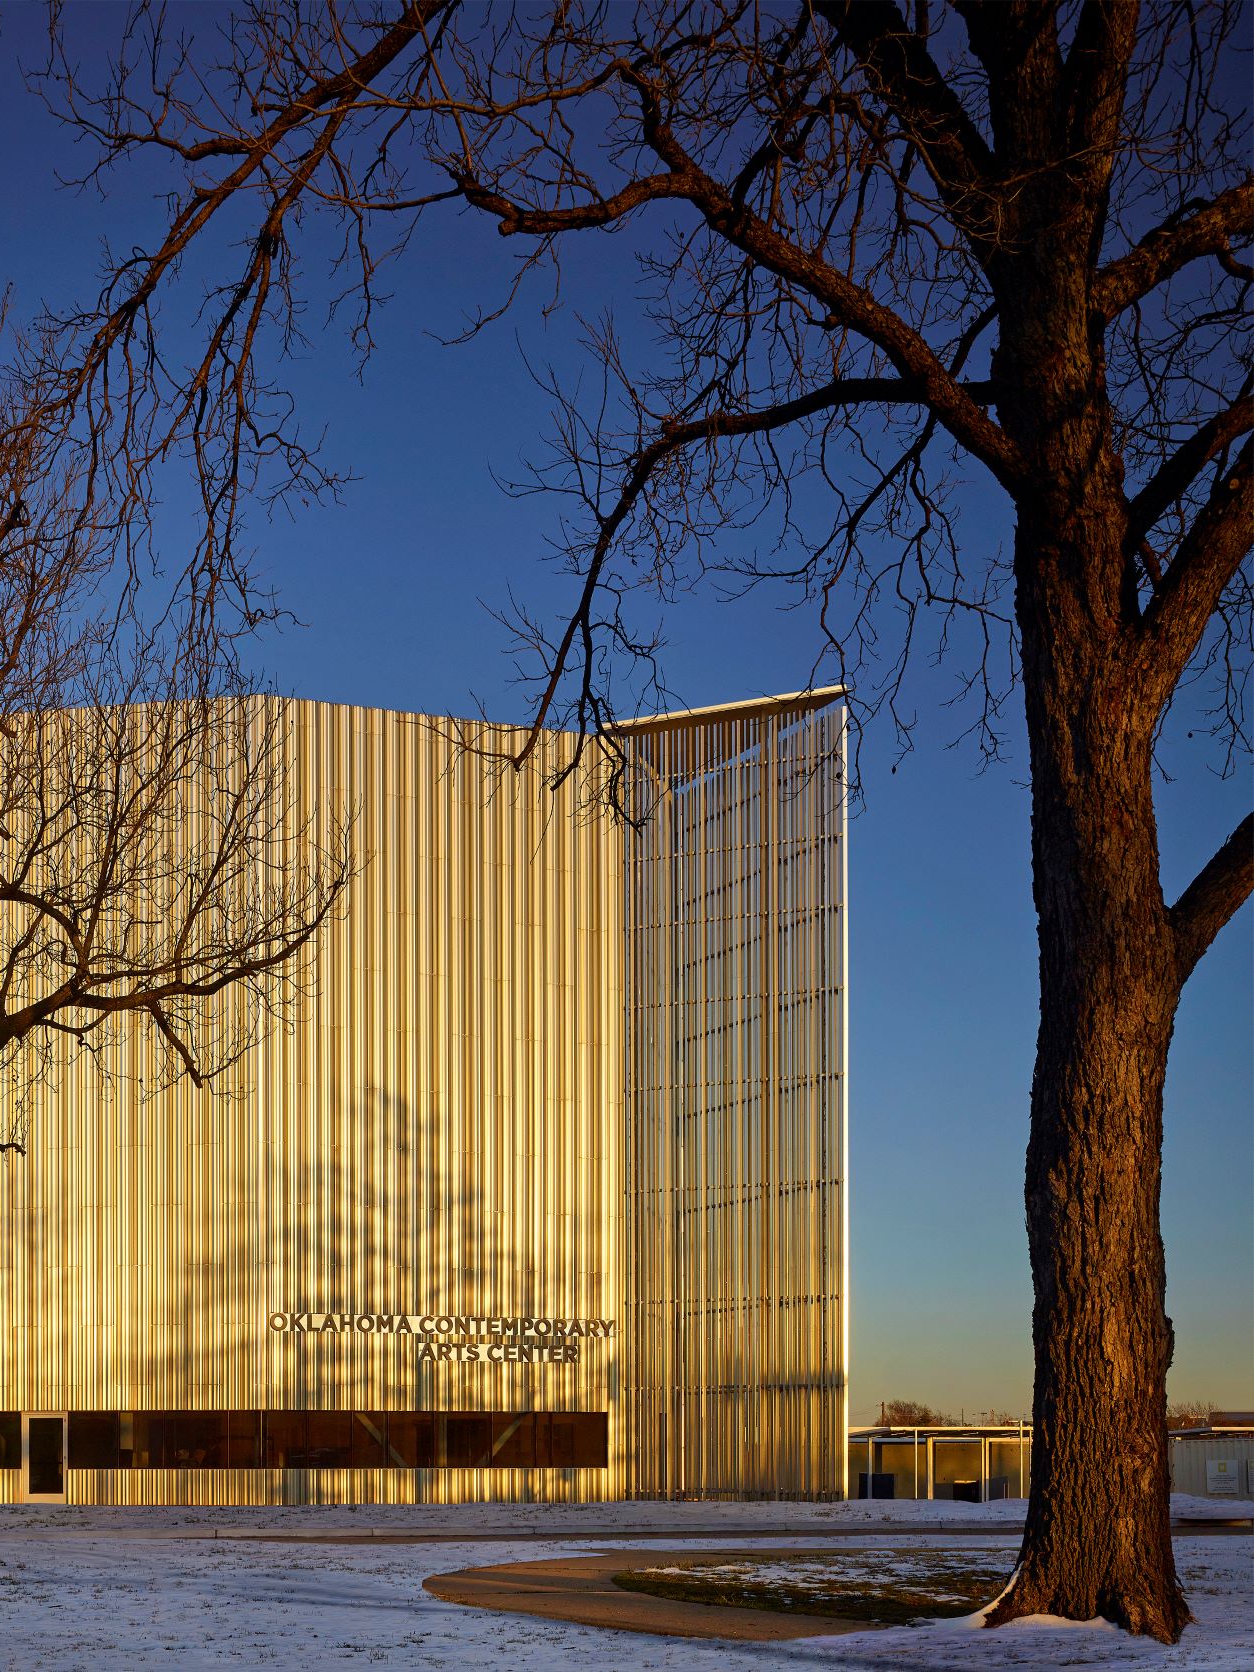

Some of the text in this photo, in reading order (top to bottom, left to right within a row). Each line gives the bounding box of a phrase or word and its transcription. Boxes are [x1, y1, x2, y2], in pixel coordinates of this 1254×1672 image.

[269, 1312, 615, 1337] OKLAHOMA CONTEMPORARY
[420, 1343, 579, 1363] ARTS CENTER
